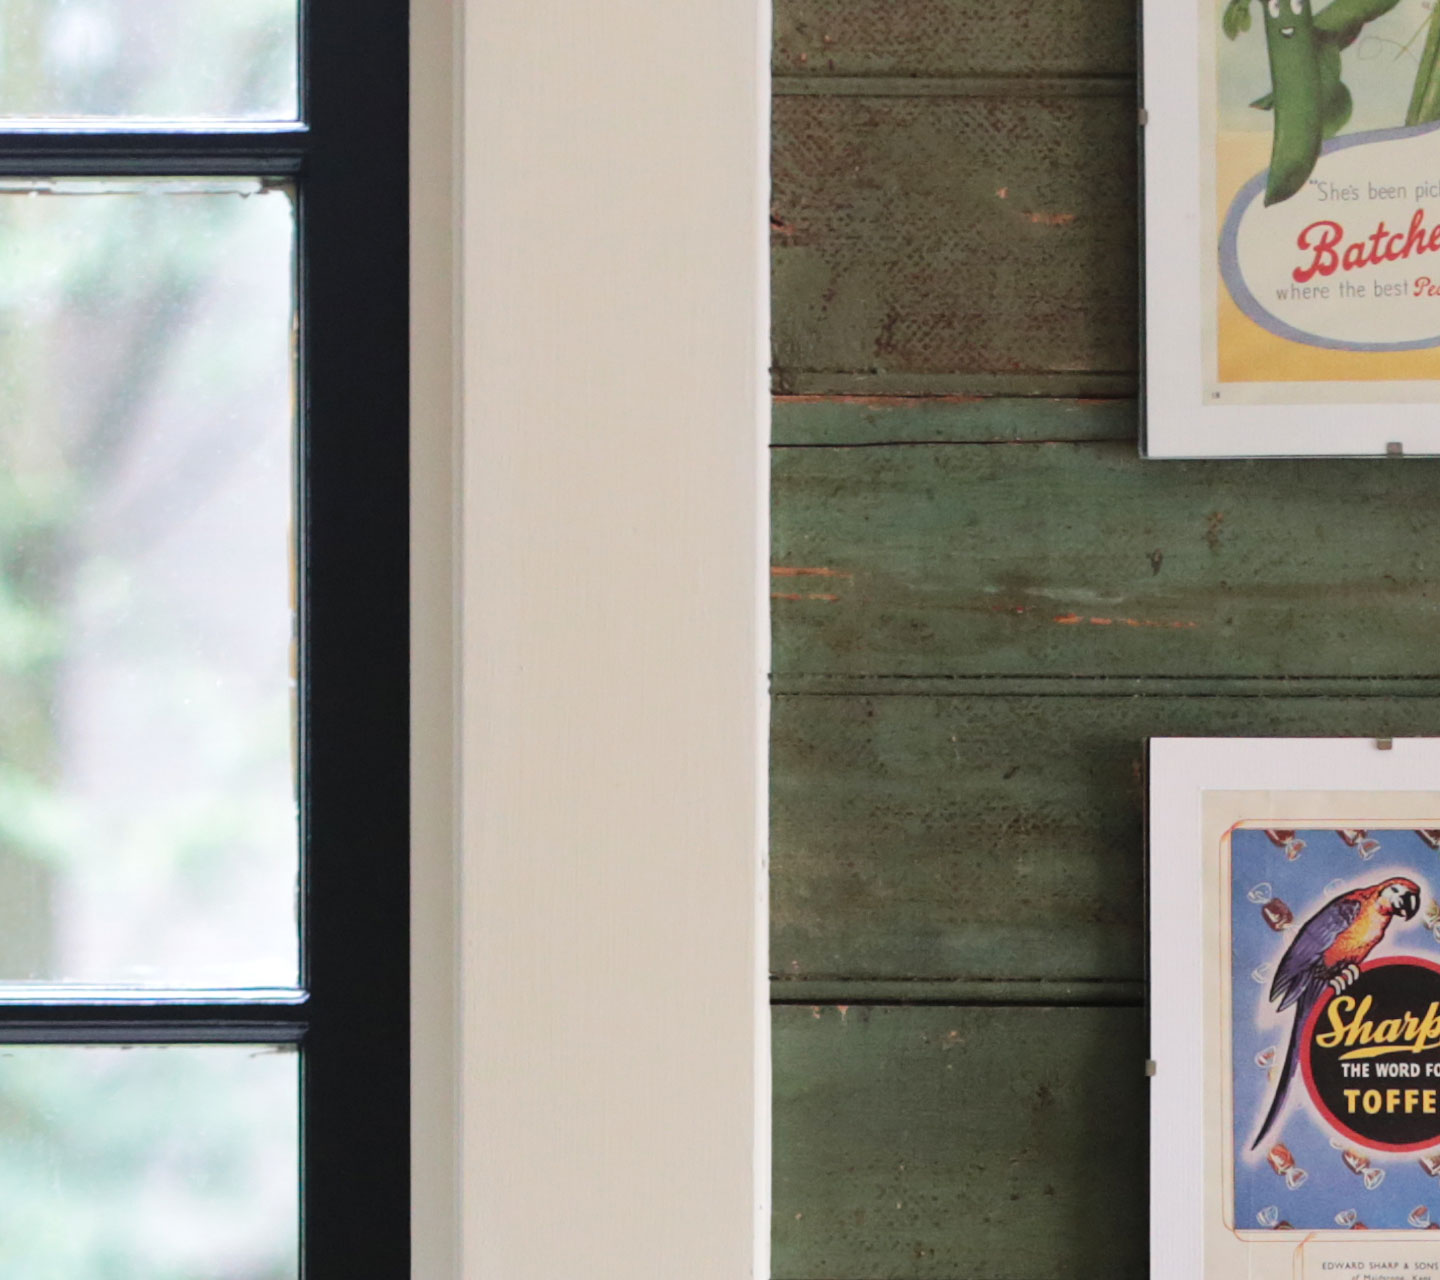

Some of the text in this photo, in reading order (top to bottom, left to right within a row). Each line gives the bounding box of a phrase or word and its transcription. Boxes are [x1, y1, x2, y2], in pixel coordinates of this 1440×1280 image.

[1368, 182, 1407, 200] been
[1276, 283, 1330, 301] where
[1339, 281, 1366, 298] the
[1374, 280, 1408, 297] best
[1341, 1062, 1370, 1078] THE
[1375, 1062, 1421, 1078] WORD
[1321, 1261, 1365, 1271] EDWARD
[1368, 1261, 1399, 1271] SHARP
[1414, 1261, 1439, 1271] SONS
